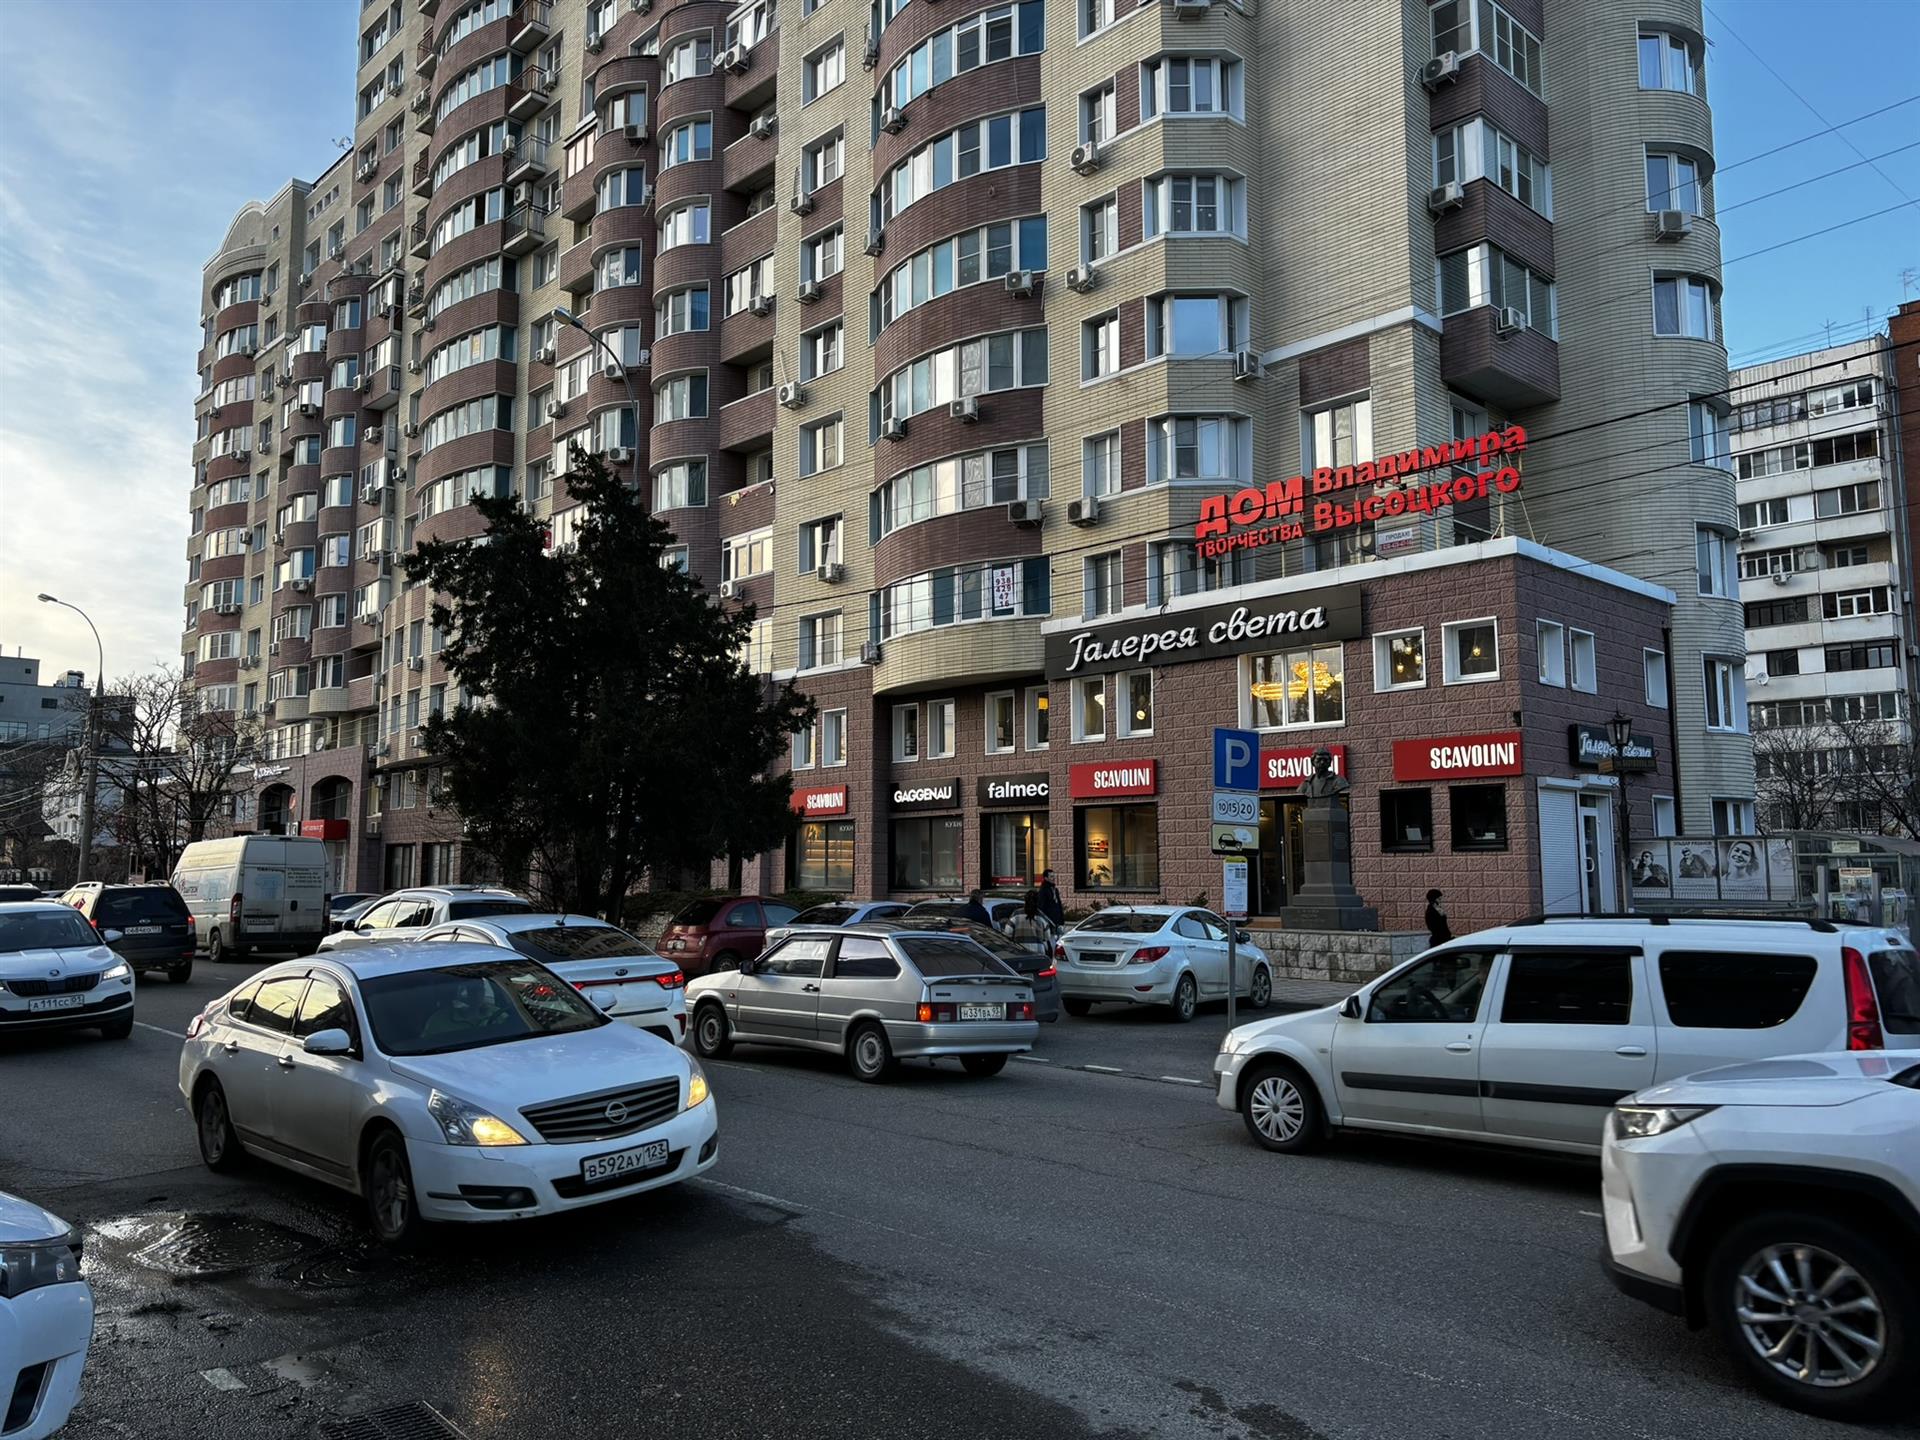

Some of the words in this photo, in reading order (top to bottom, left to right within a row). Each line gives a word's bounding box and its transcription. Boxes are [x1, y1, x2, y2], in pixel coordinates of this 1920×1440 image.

[1313, 426, 1527, 495] Владимира
[1195, 476, 1305, 540] ДОМ
[1314, 466, 1521, 532] Высоцкого
[1195, 522, 1304, 559] ТВОРЧЕСТВА
[995, 577, 1011, 585] 938
[1066, 627, 1198, 672] Галерея
[1208, 606, 1325, 644] света
[1430, 742, 1515, 769] SCAVOLINI
[987, 781, 1048, 799] falmec
[1093, 767, 1150, 788] SCAVOLINI
[806, 791, 843, 809] SCAVOLINI
[893, 786, 952, 803] GAGGENAU
[1218, 802, 1227, 811] 10
[1229, 803, 1238, 813] 15
[1240, 803, 1252, 814] 20
[588, 1152, 642, 1178] В592АУ
[645, 1143, 665, 1158] 123
